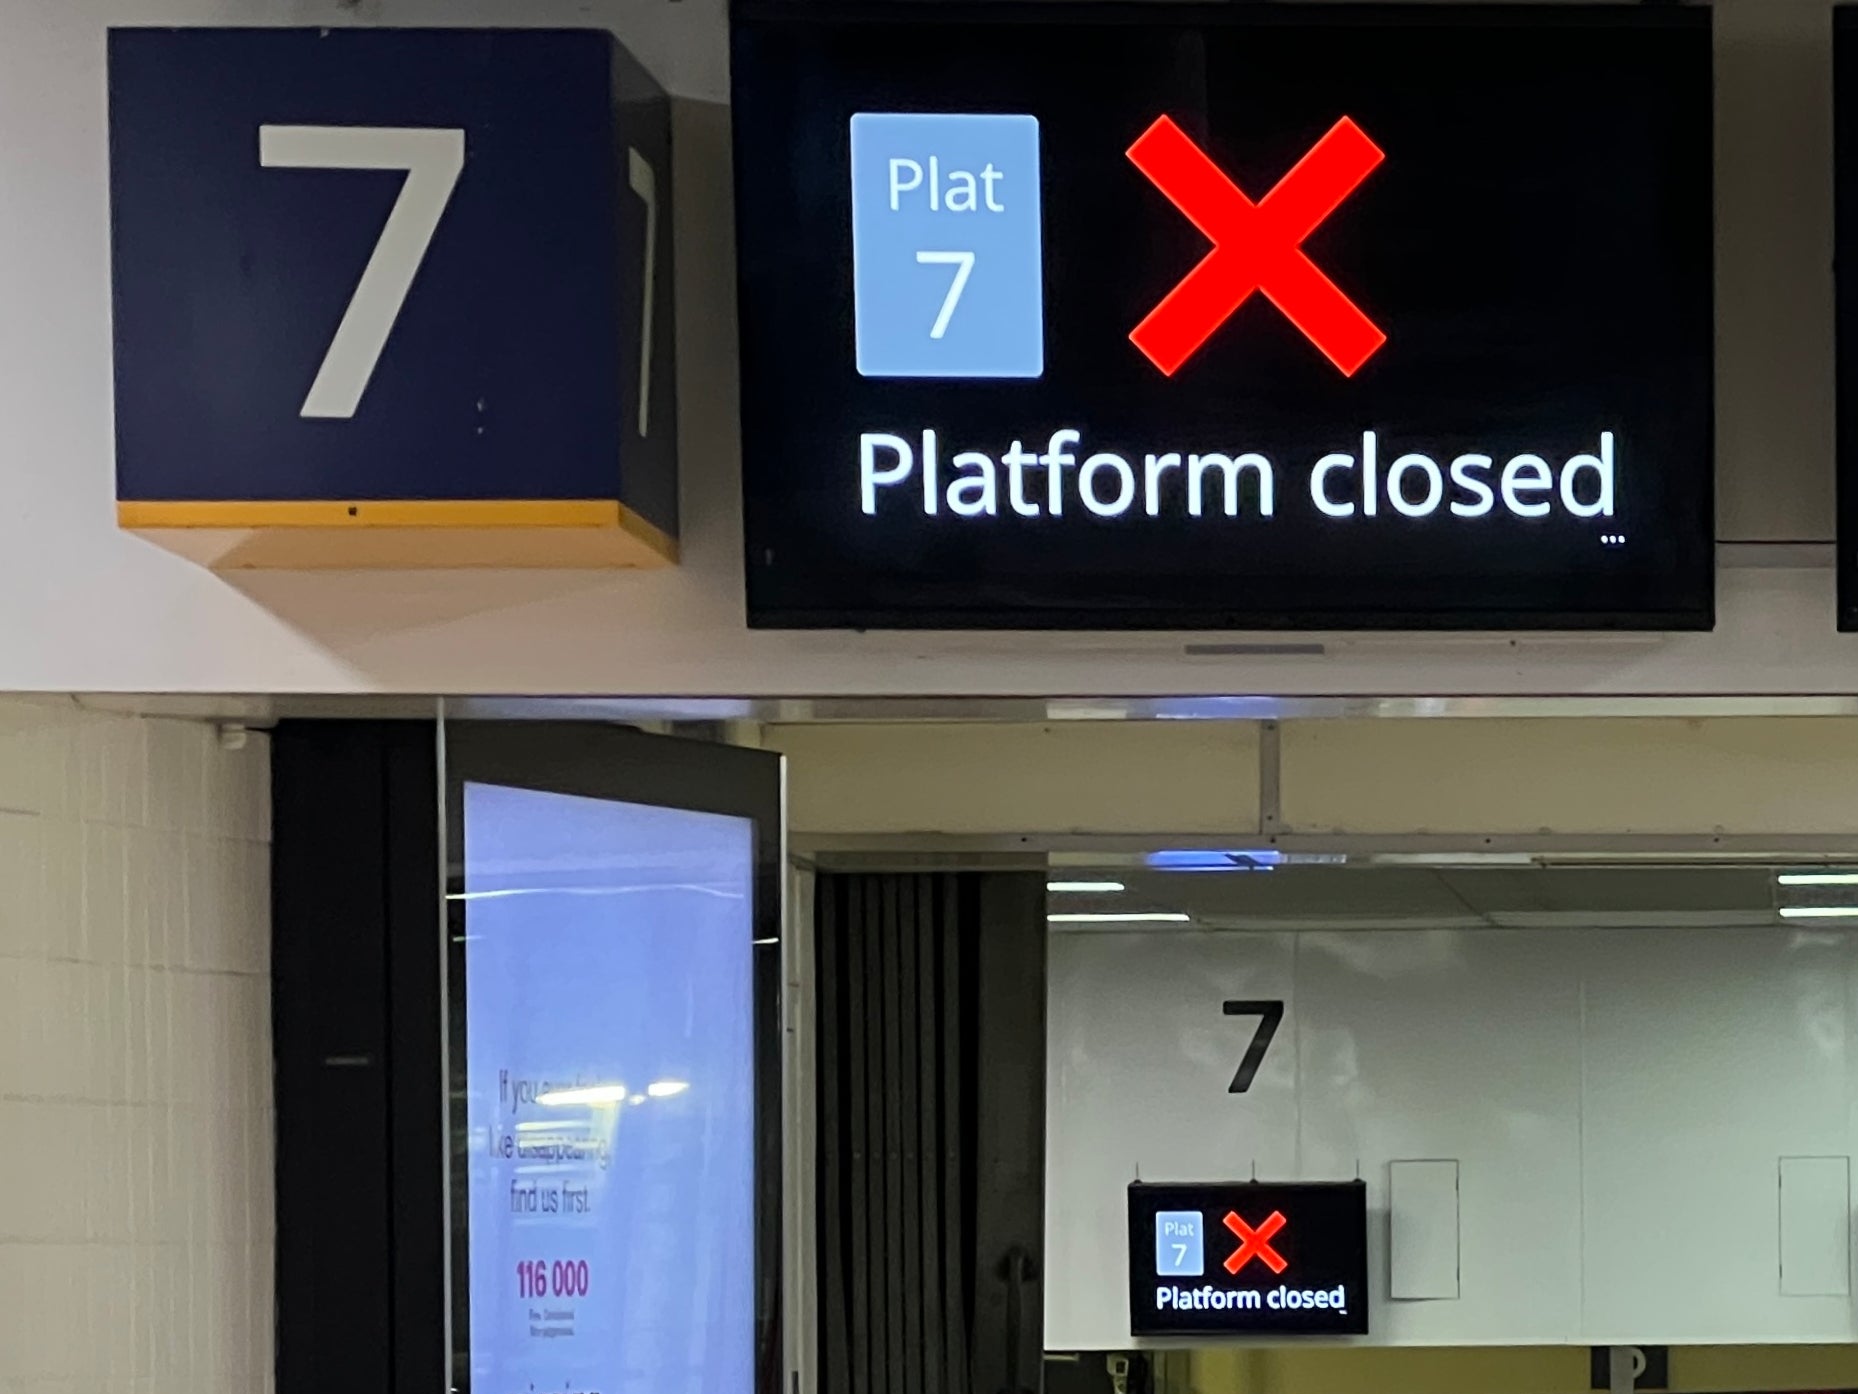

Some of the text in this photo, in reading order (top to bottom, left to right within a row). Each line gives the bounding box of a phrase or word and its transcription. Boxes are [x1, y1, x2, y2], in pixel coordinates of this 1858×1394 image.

[888, 157, 1005, 213] Plat
[259, 124, 466, 419] 7
[915, 250, 976, 340] 7
[859, 428, 1615, 518] Platform closed
[1221, 1000, 1285, 1094] 7
[1164, 1221, 1195, 1238] Plat
[1170, 1243, 1188, 1268] 7
[516, 1259, 589, 1298] 116 000
[1156, 1284, 1346, 1311] Platform closed
